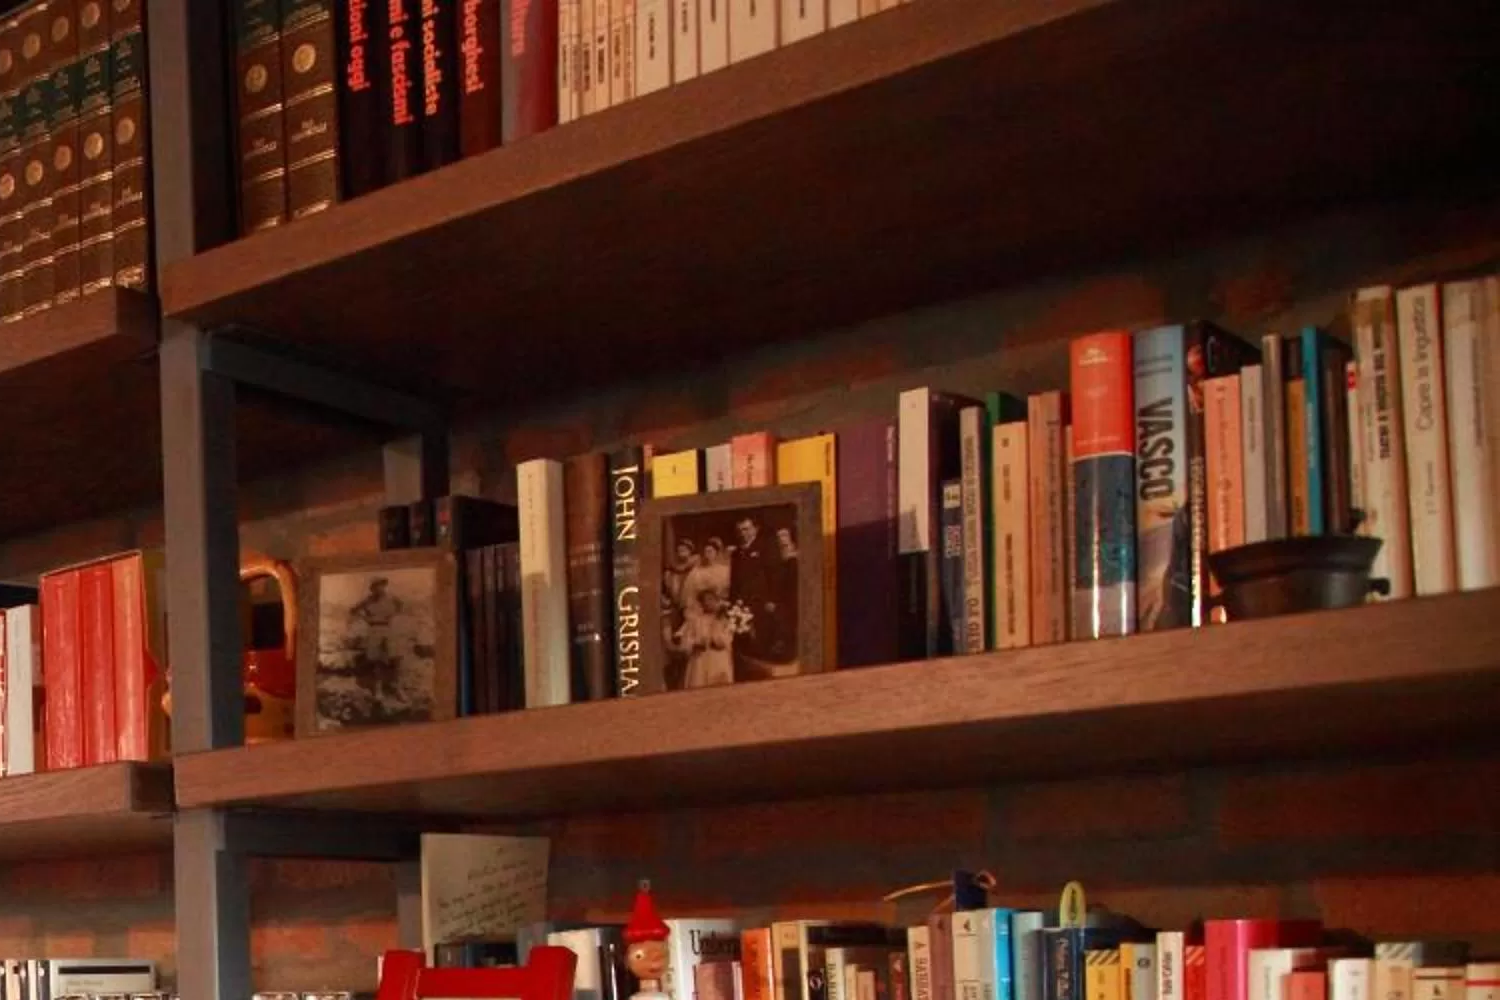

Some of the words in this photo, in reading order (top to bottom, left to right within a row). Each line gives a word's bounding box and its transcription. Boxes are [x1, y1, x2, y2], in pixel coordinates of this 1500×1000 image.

[612, 462, 641, 542] JOHN
[1138, 396, 1174, 502] VASCO
[618, 584, 641, 702] GRISHA
